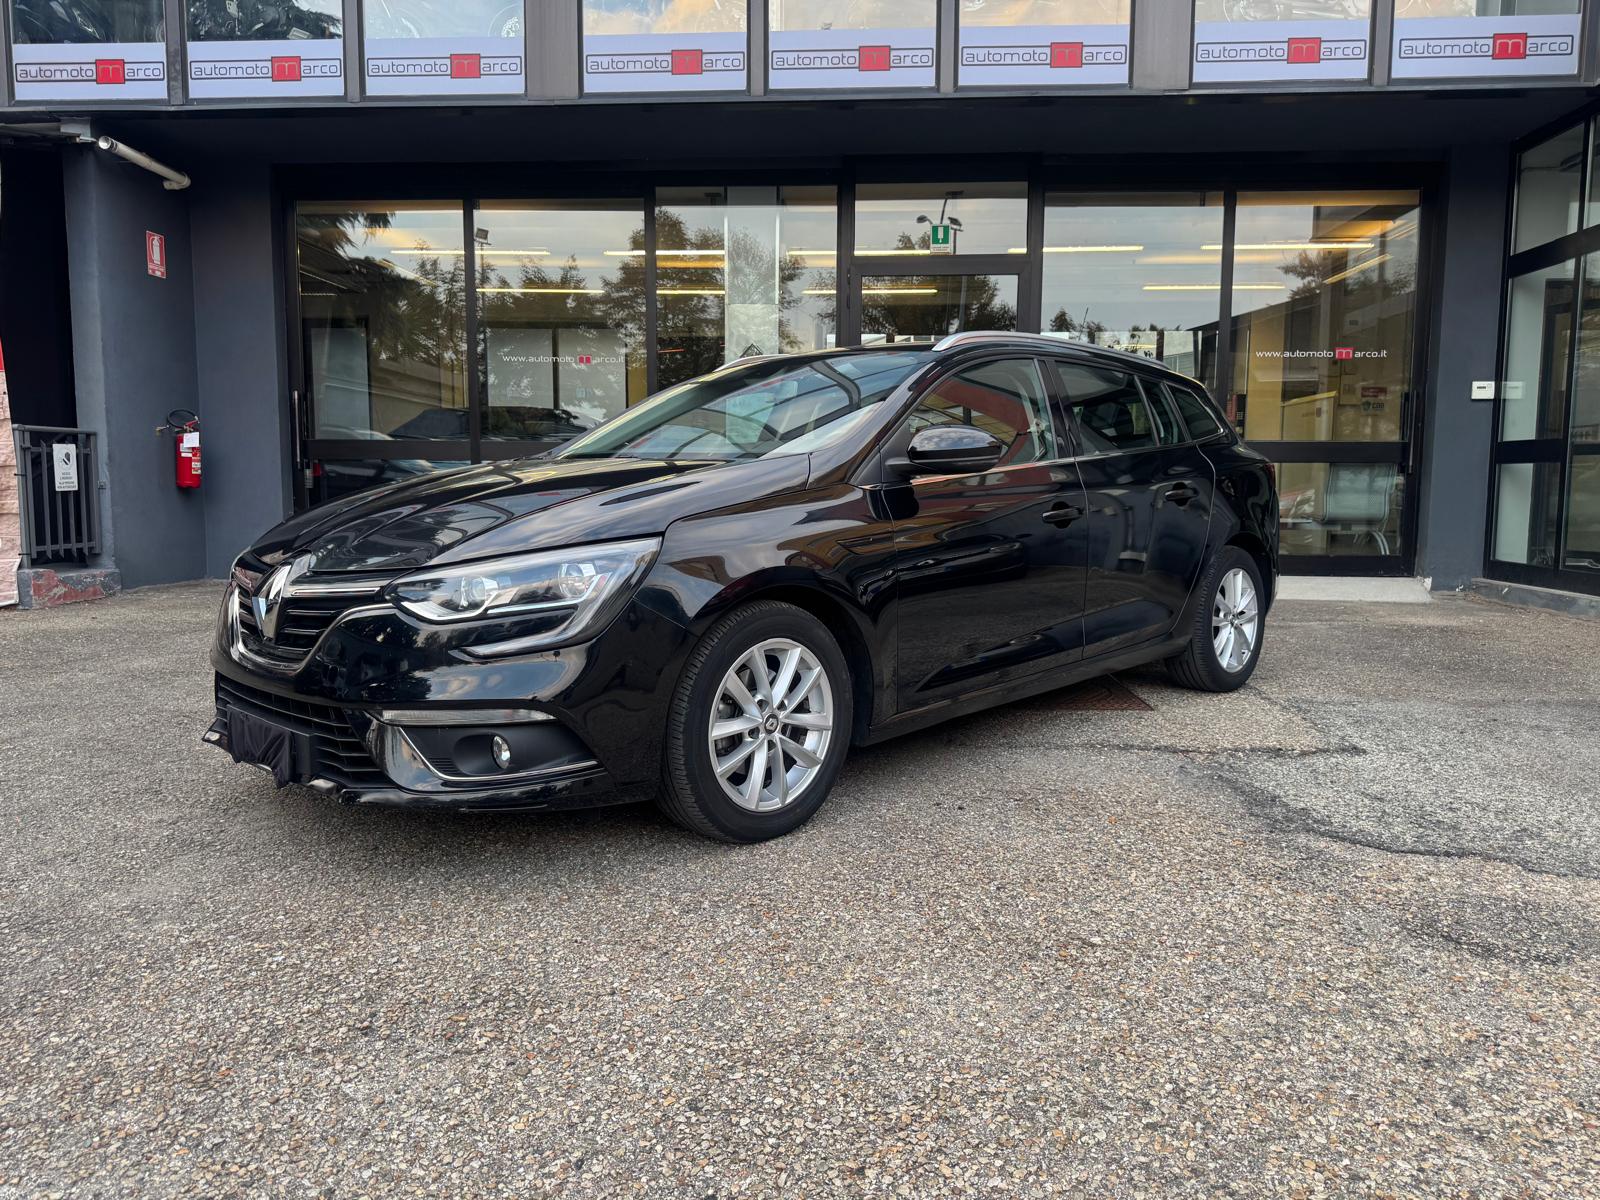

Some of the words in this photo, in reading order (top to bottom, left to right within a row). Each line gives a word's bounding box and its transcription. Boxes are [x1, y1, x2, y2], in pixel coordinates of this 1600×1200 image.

[1200, 45, 1285, 59] automoto
[1403, 41, 1490, 55] automoto
[775, 53, 857, 67] automoto
[965, 49, 1048, 63] automoto
[194, 63, 270, 76] automoto
[370, 60, 449, 74] automoto
[590, 57, 669, 70] automoto
[19, 63, 94, 79] automoto
